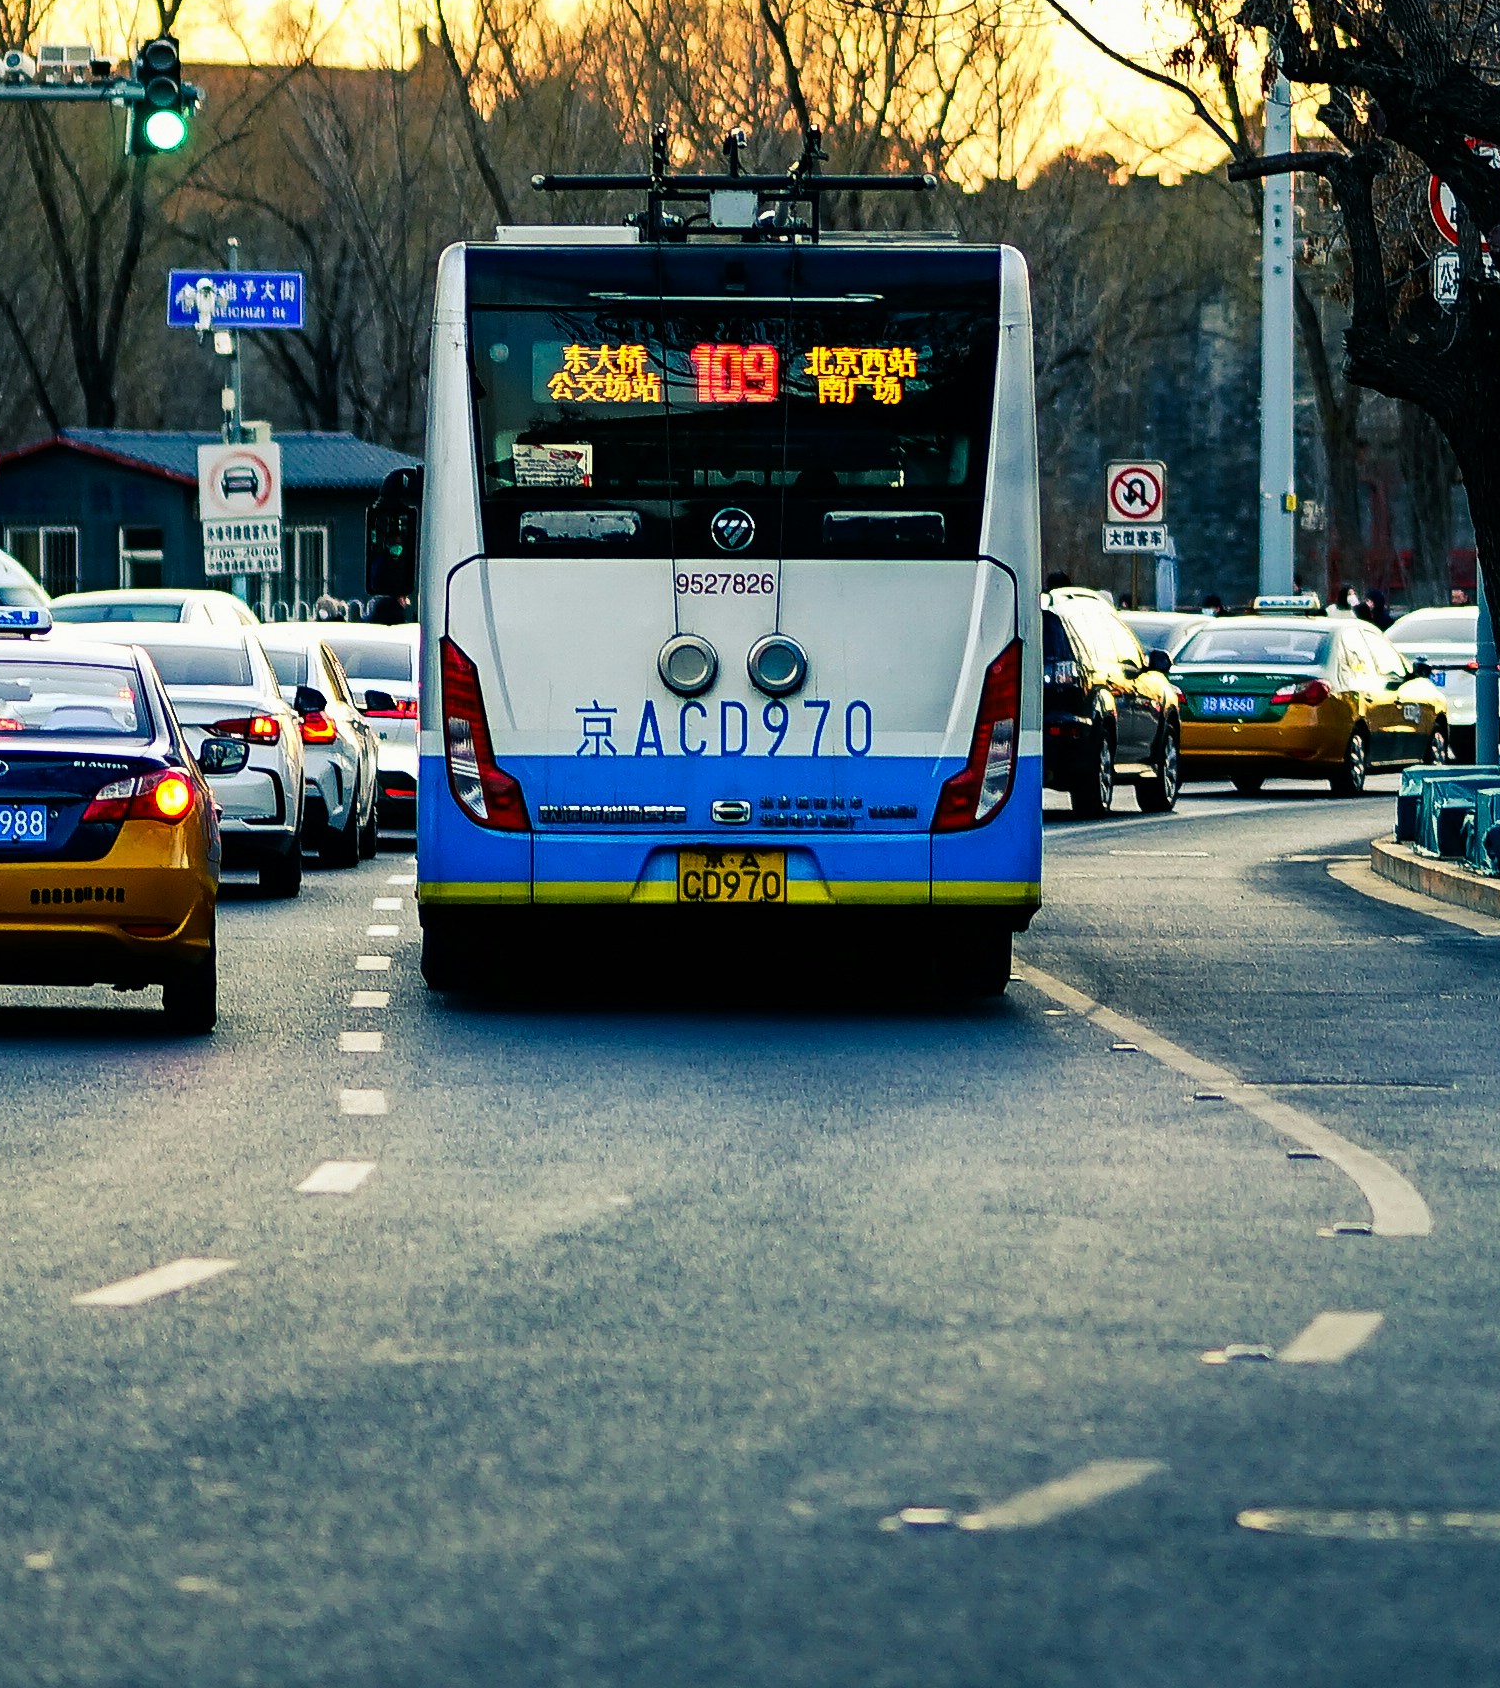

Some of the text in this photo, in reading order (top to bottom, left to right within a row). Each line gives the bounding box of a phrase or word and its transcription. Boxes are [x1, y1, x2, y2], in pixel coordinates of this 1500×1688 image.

[562, 344, 648, 375] 东大桥
[690, 343, 779, 403] 109
[803, 346, 918, 377] 北京西站
[547, 373, 662, 403] 公交场站
[818, 376, 903, 404] 南广场
[675, 573, 775, 595] 9527826
[575, 699, 873, 758] 京ACD970
[682, 870, 781, 900] CD970
